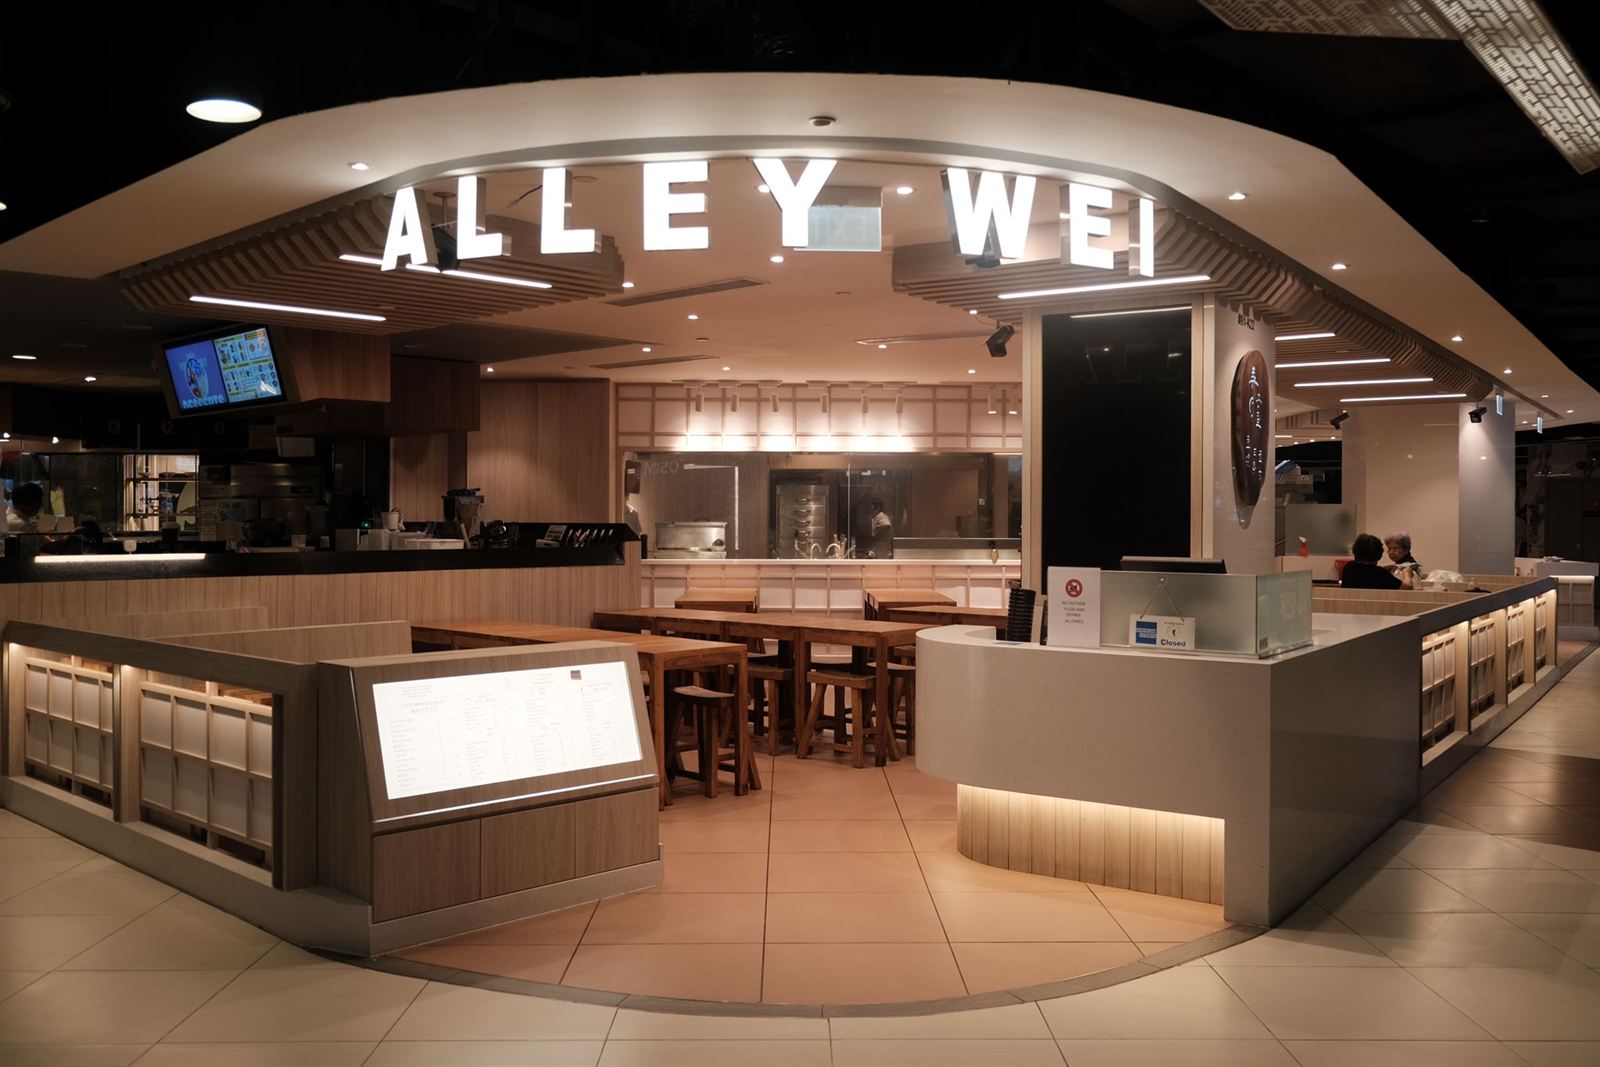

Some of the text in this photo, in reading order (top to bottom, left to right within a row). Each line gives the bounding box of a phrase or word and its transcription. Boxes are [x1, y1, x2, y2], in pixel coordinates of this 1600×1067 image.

[380, 157, 1155, 278] ALLEY WEI
[1160, 638, 1186, 647] Closed
